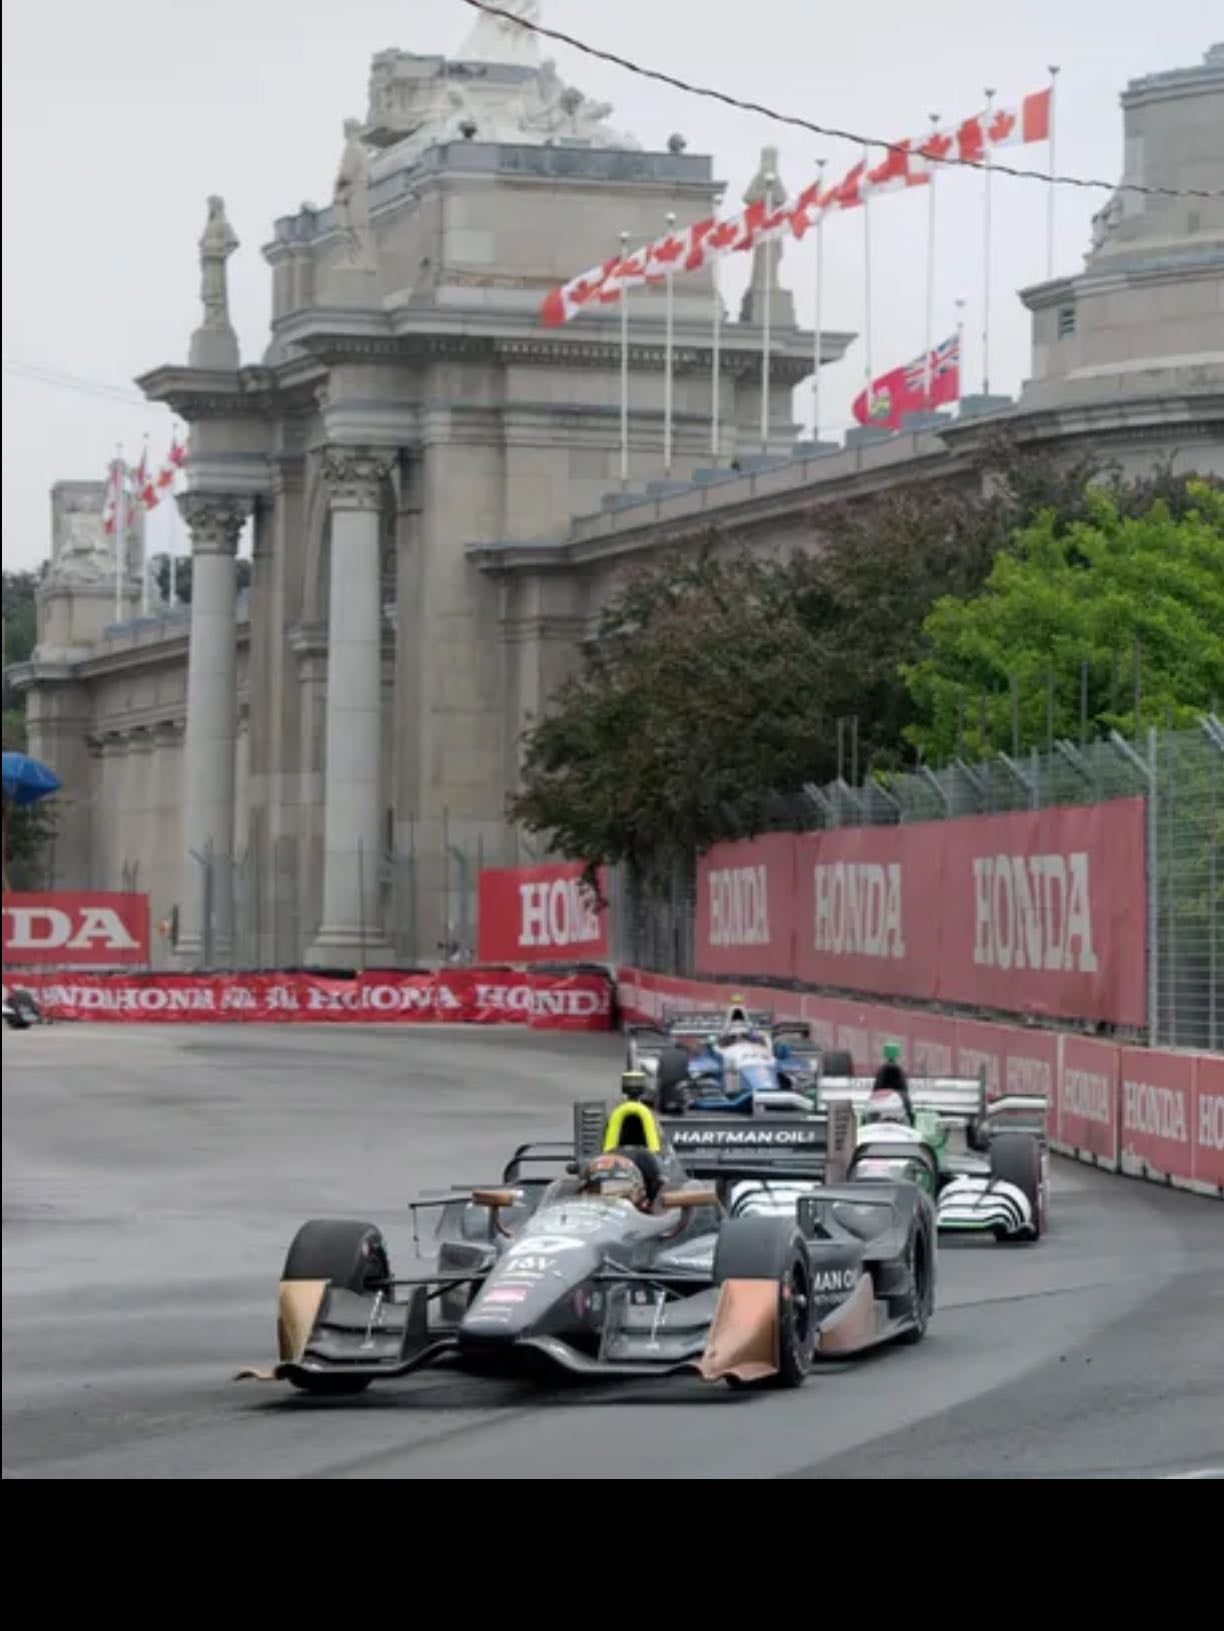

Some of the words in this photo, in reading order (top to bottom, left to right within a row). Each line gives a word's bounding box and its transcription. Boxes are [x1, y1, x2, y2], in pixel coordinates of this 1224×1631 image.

[708, 864, 770, 947] HONDA
[814, 861, 905, 958] HONDA
[972, 852, 1098, 972] HONDA
[673, 1130, 772, 1143] HARTMAN
[1123, 1080, 1189, 1142] HONDA
